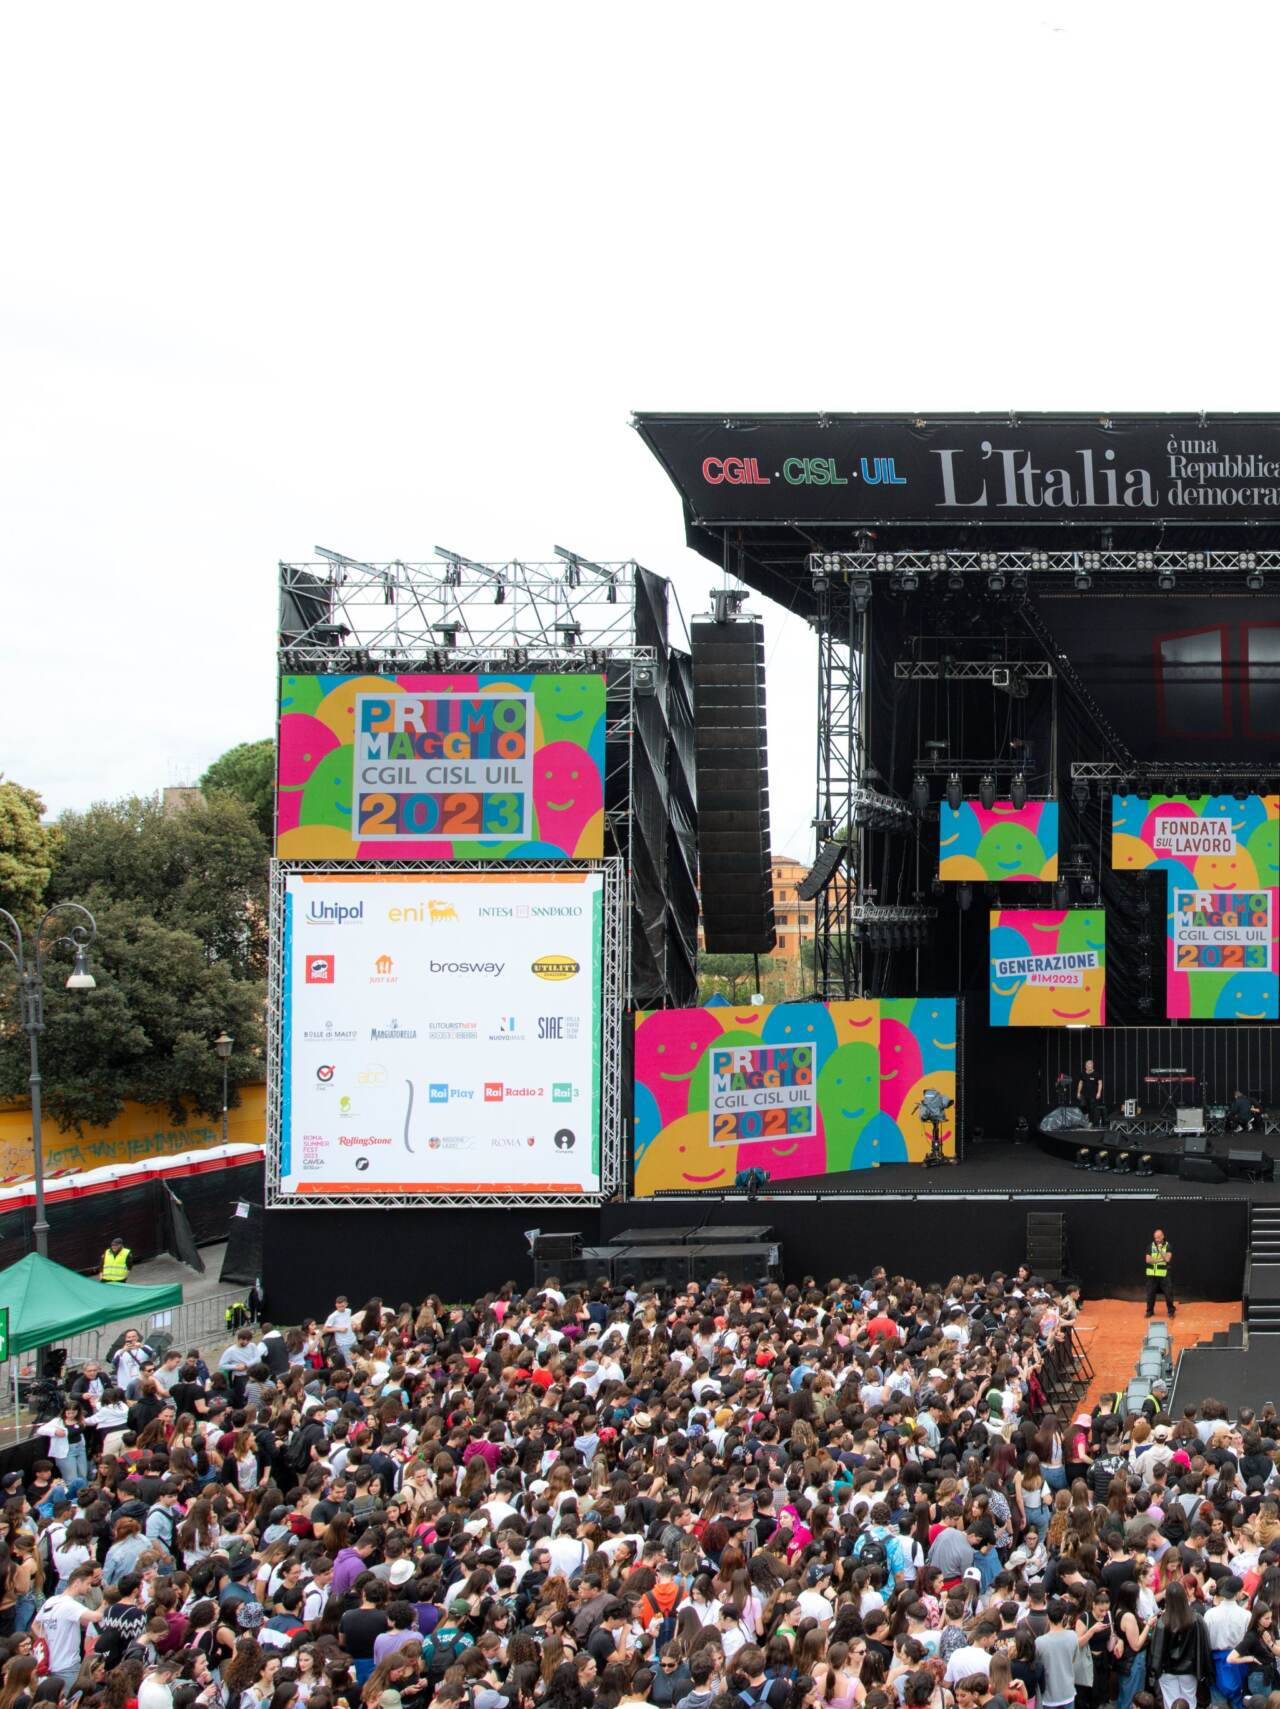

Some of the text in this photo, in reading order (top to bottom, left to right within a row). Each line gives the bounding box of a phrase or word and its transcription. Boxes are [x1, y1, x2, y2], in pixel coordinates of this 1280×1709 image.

[1167, 434, 1218, 455] è una
[703, 457, 907, 485] CGIL CISL UIL
[930, 440, 1159, 508] L'Italia
[361, 699, 527, 733] PRIMO
[362, 731, 527, 760] MAGGIO
[361, 766, 523, 785] CGIL CISL UIL
[359, 793, 522, 835] 2023
[1161, 821, 1227, 836] FONDATA
[1155, 838, 1232, 853] SUL LAVORO
[478, 907, 513, 917] INTESA
[1177, 893, 1268, 912] PRIMO
[310, 901, 364, 925] Unipol
[388, 903, 424, 923] eni
[1178, 911, 1268, 928] MAGGIO
[1178, 930, 1267, 941] CGIL CISL UIL
[999, 953, 1096, 975] GENERAZIONE
[1178, 945, 1266, 968] 2023
[429, 960, 506, 977] brosway
[534, 964, 576, 972] UTILITY
[538, 1016, 564, 1039] SIAE
[713, 1047, 812, 1074] PRIMO
[715, 1068, 812, 1092] MAGGIO
[431, 1087, 475, 1100] Rai Play
[486, 1086, 544, 1098] Rai Radio 2
[553, 1087, 571, 1098] Rai
[714, 1090, 811, 1109] CGIL CISL UIL
[714, 1107, 810, 1142] 2023
[338, 1136, 393, 1147] RollingStone
